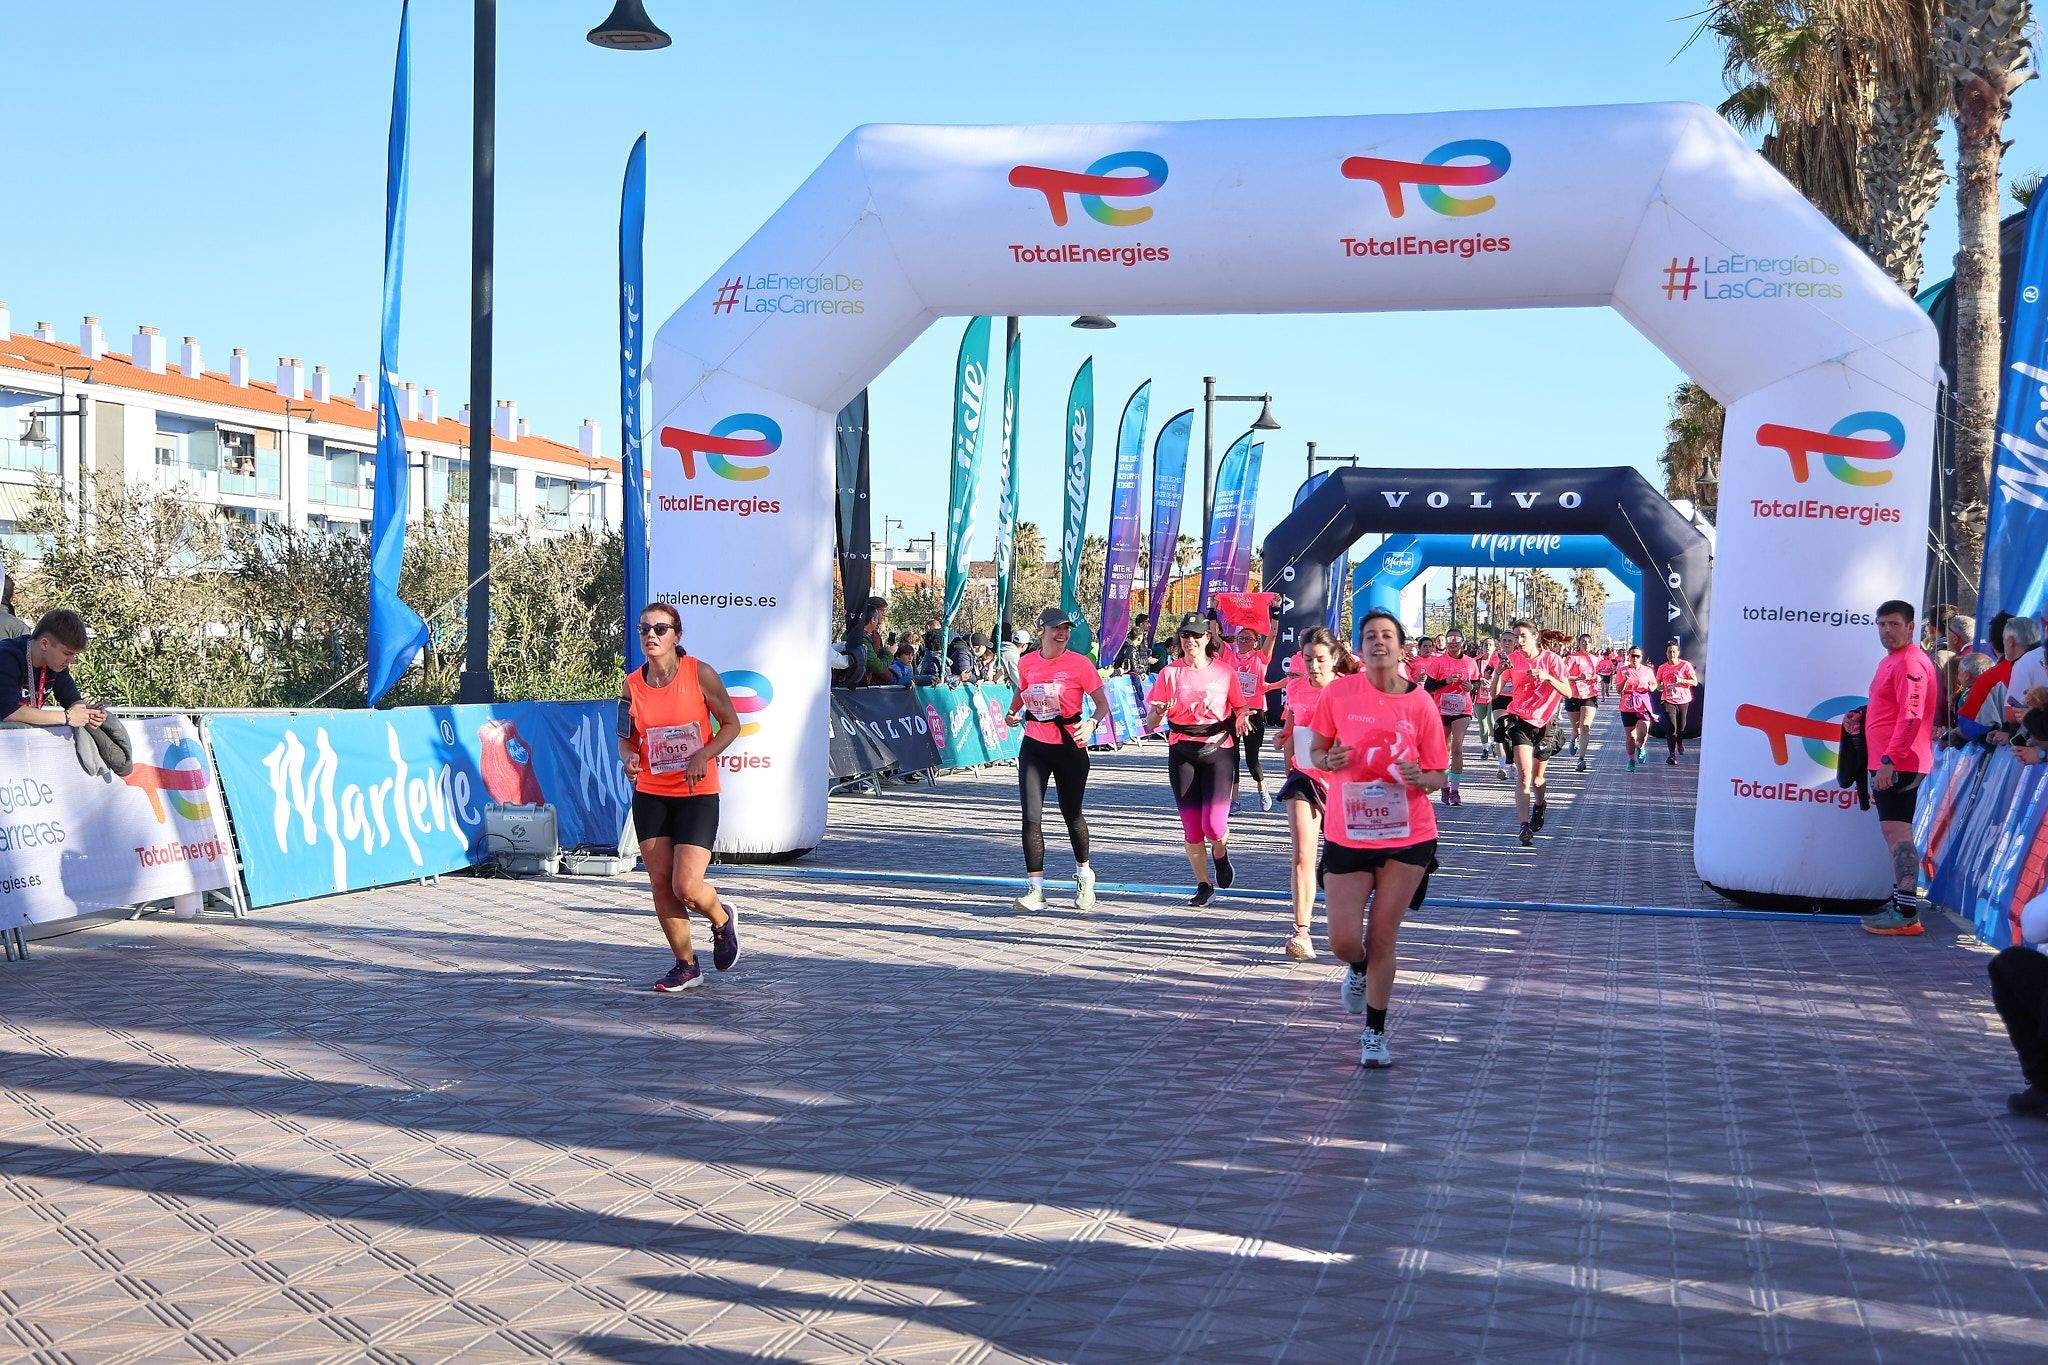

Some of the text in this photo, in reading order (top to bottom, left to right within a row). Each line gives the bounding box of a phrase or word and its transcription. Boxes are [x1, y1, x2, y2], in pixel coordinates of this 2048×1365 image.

[1008, 242, 1170, 267] TotalEnergies
[1340, 233, 1511, 258] TotalEnergies
[1704, 278, 1844, 300] LasCarreras
[744, 294, 864, 314] LasCarreras
[658, 495, 781, 517] TotalEnergies
[1380, 491, 1582, 509] VOLVO
[1750, 500, 1901, 526] TotalEnergies
[656, 591, 777, 609] totalenergies.es
[262, 720, 481, 892] Marlene
[1365, 807, 1389, 818] 016
